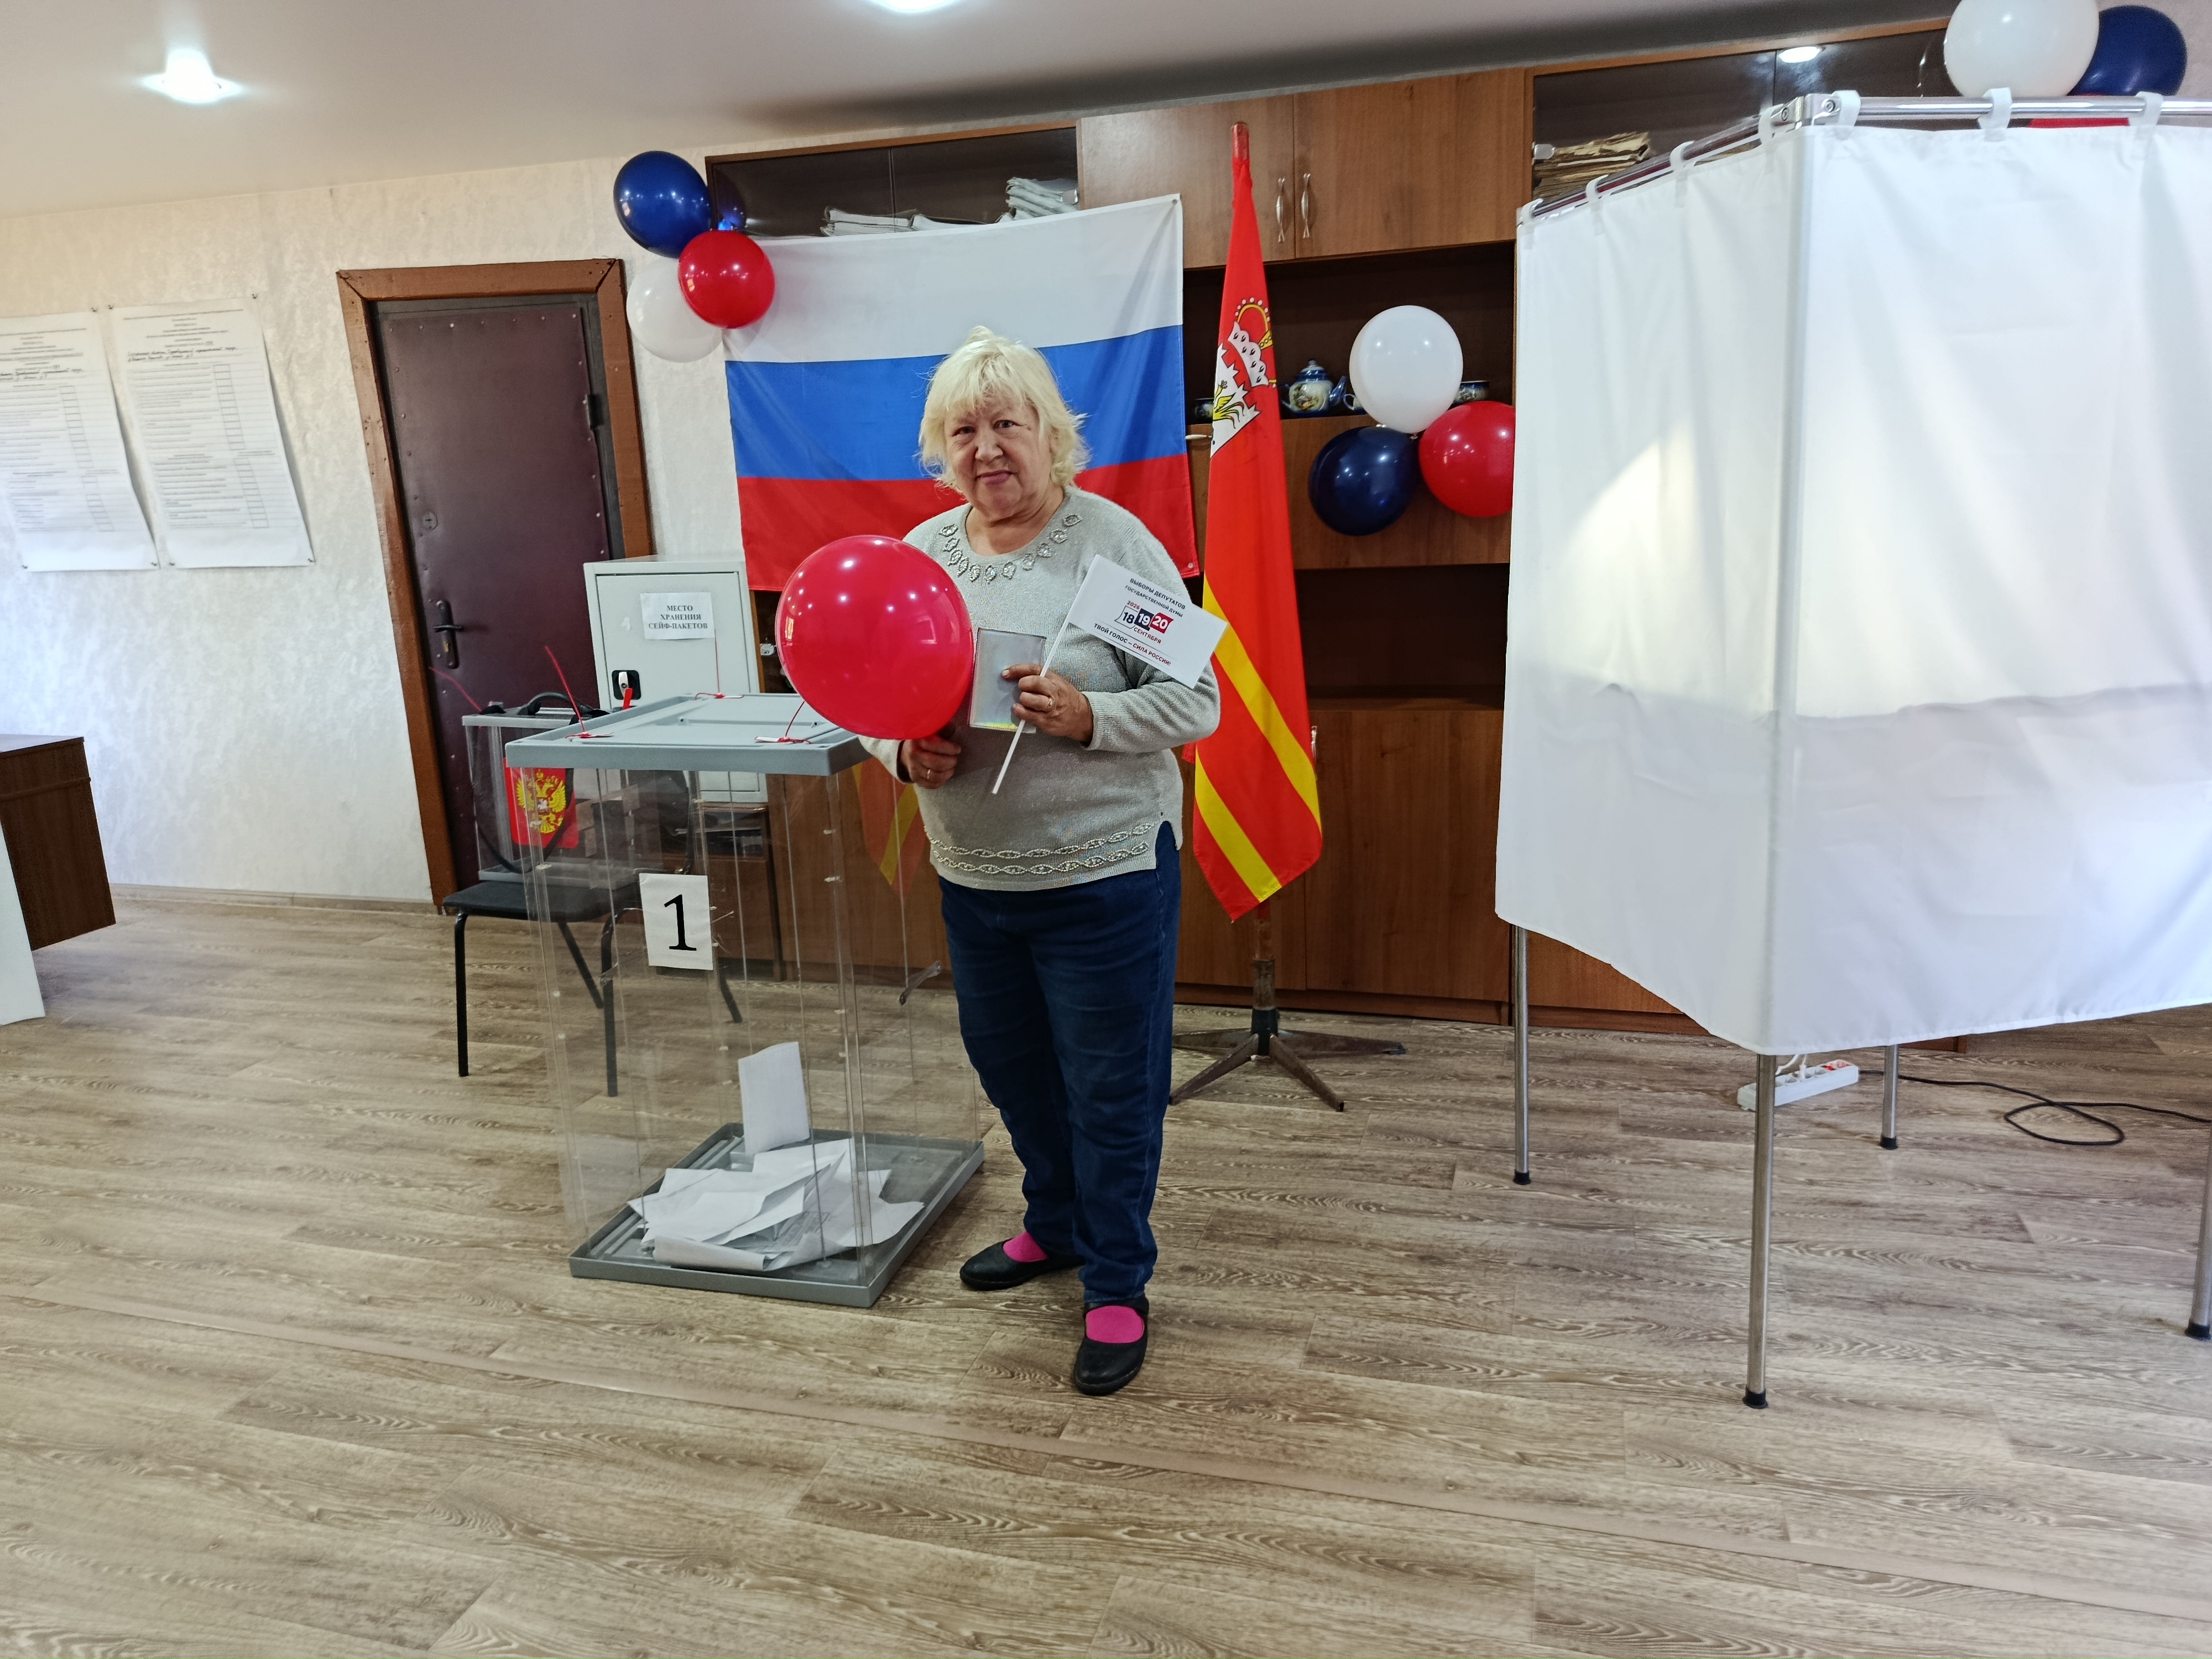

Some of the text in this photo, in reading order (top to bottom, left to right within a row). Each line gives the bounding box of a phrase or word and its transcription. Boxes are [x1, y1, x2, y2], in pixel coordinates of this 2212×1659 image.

[1125, 585, 1183, 617] ГОСУДАРСТВЕННОЙ ДУМЫ
[1127, 600, 1140, 609] 2026
[1130, 578, 1186, 609] ВЫБОРЫ ДЕПУТАТОВ
[1123, 612, 1168, 629] 18 19 20
[1134, 627, 1162, 644] СЕНТЯБРЯ
[1094, 623, 1109, 634] ТВОЙ
[1109, 631, 1128, 643] ГОЛОС
[1133, 643, 1147, 654] СИЛА
[1149, 651, 1171, 666] РОССИИ!
[664, 894, 697, 951] 1
